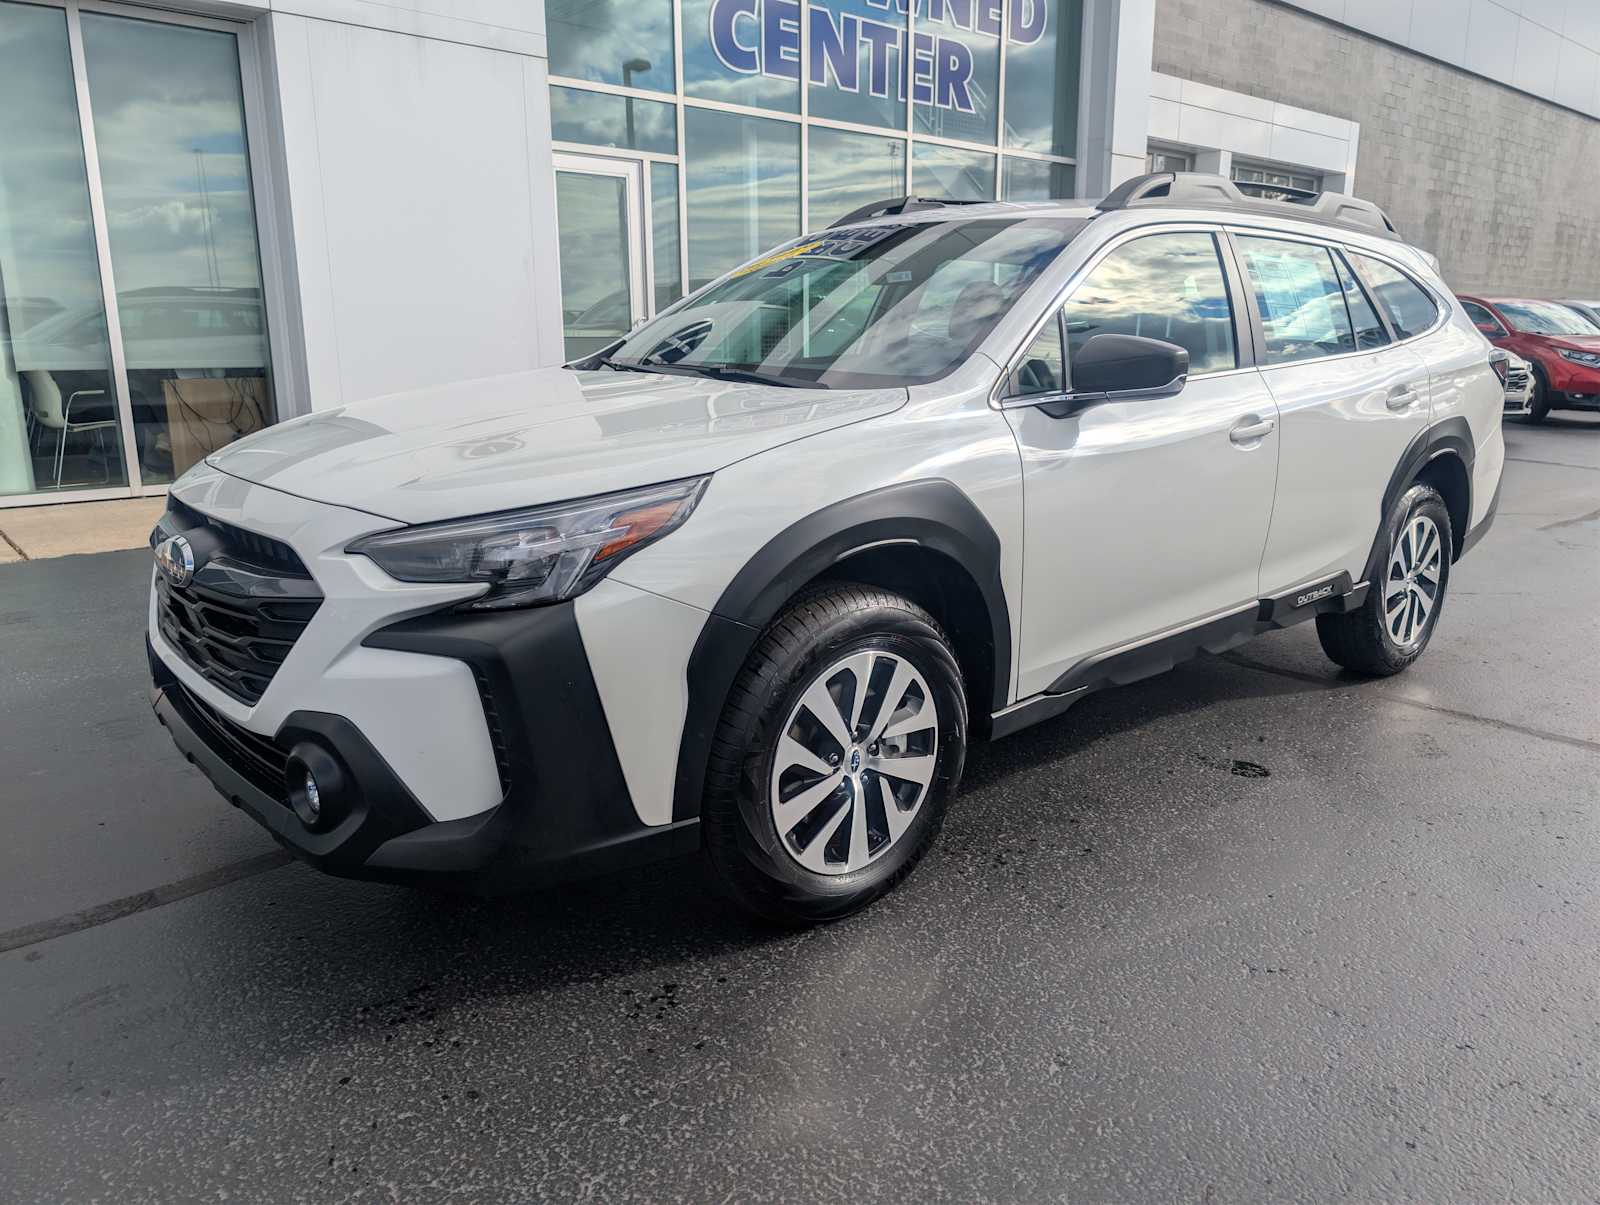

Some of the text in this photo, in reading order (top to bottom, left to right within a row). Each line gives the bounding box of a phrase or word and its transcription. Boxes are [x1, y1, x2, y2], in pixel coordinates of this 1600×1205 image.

[865, 0, 1048, 45] ED
[708, 0, 977, 114] CENTER
[1297, 585, 1334, 604] OUTBACK
